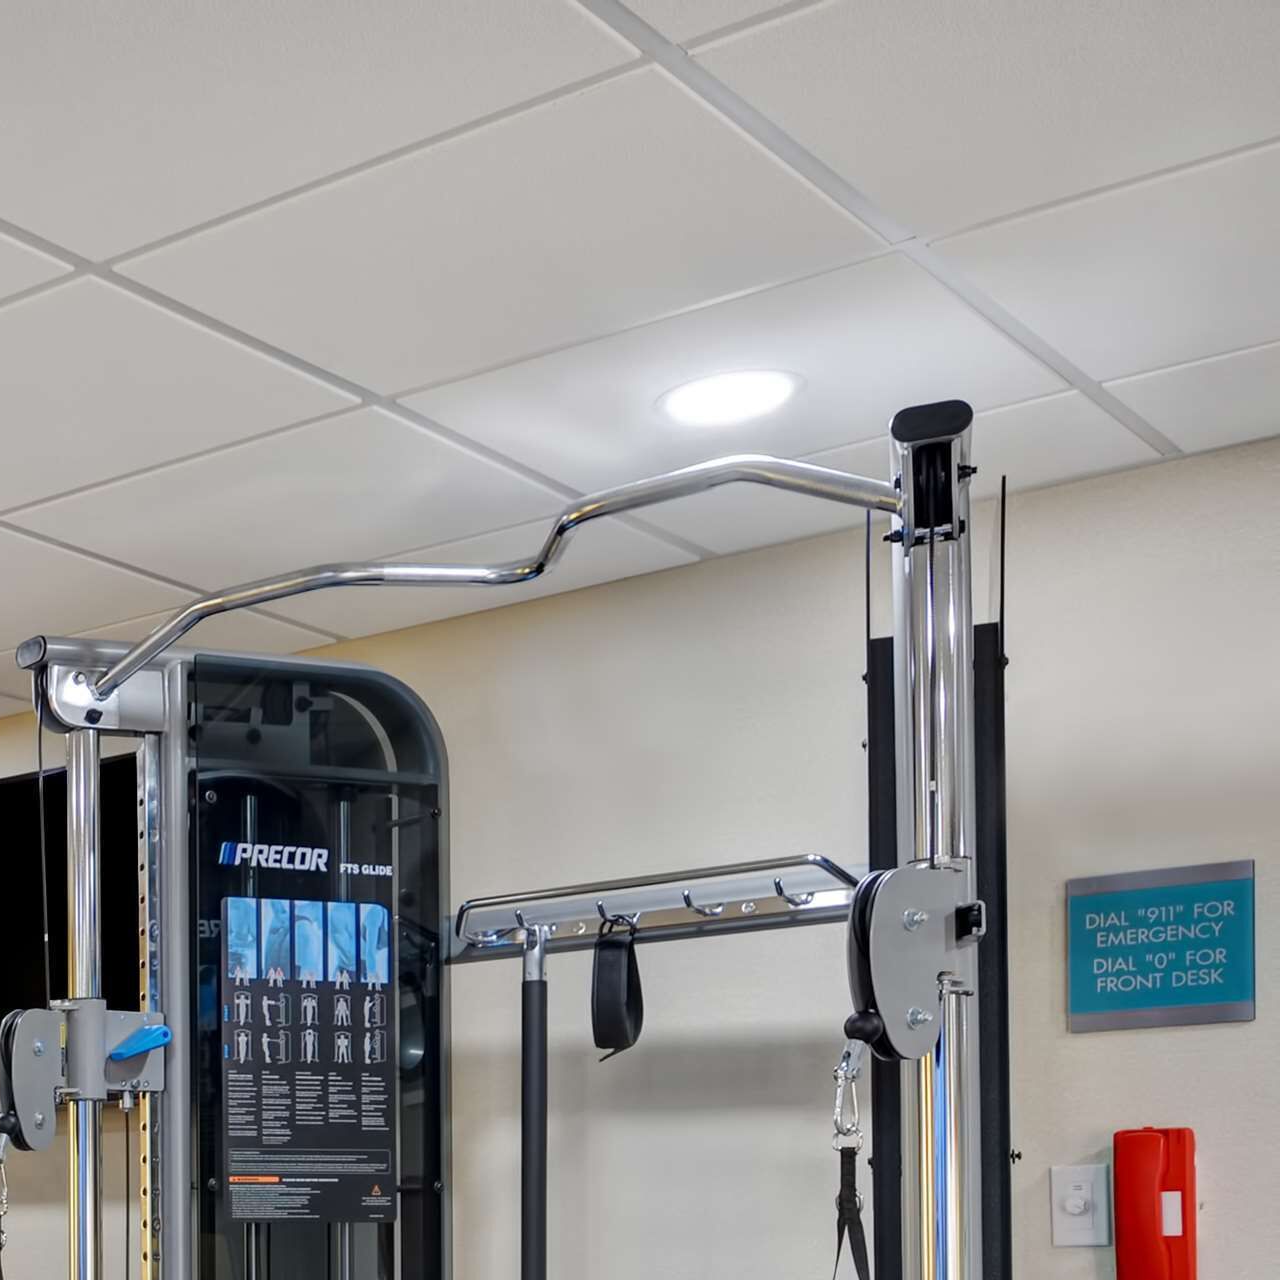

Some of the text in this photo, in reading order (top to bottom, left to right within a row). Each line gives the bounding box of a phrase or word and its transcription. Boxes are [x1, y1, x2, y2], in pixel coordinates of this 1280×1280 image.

[233, 842, 329, 872] PRECOR
[339, 863, 393, 876] FTS GLIDE
[1085, 900, 1235, 929] DIAL "911" FOR
[1096, 921, 1224, 948] EMERGENCY
[1093, 948, 1227, 974] DIAL "0" FOR
[1096, 968, 1224, 993] FRONT DESK
